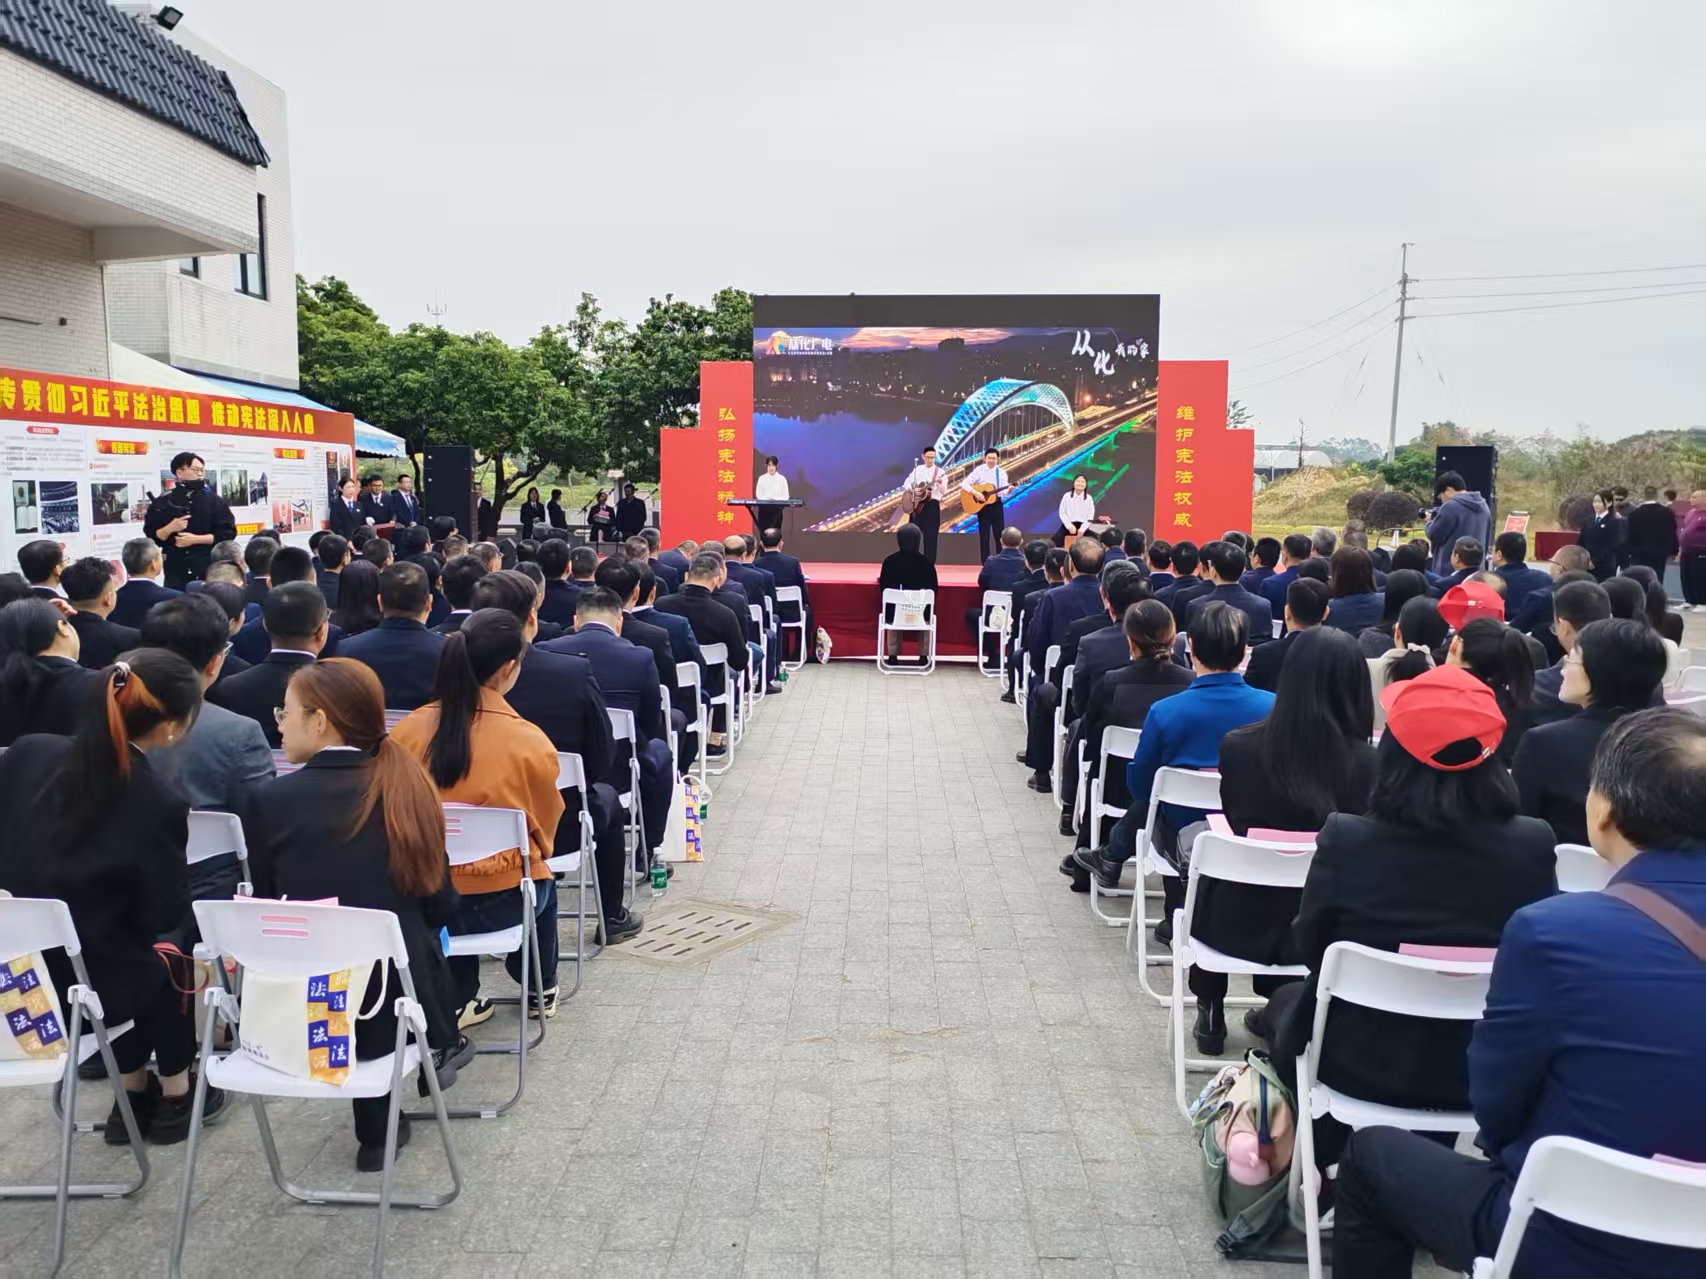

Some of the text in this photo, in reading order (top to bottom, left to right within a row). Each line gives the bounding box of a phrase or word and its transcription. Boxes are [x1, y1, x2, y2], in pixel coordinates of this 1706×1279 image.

[1115, 342, 1150, 359] 我的家
[717, 407, 736, 525] 弘扬宪法精神
[1173, 405, 1195, 527] 维护宪法权威
[13, 1014, 32, 1031] 法
[40, 1019, 58, 1038] 法
[313, 1025, 328, 1044] 法
[331, 1043, 347, 1062] 法
